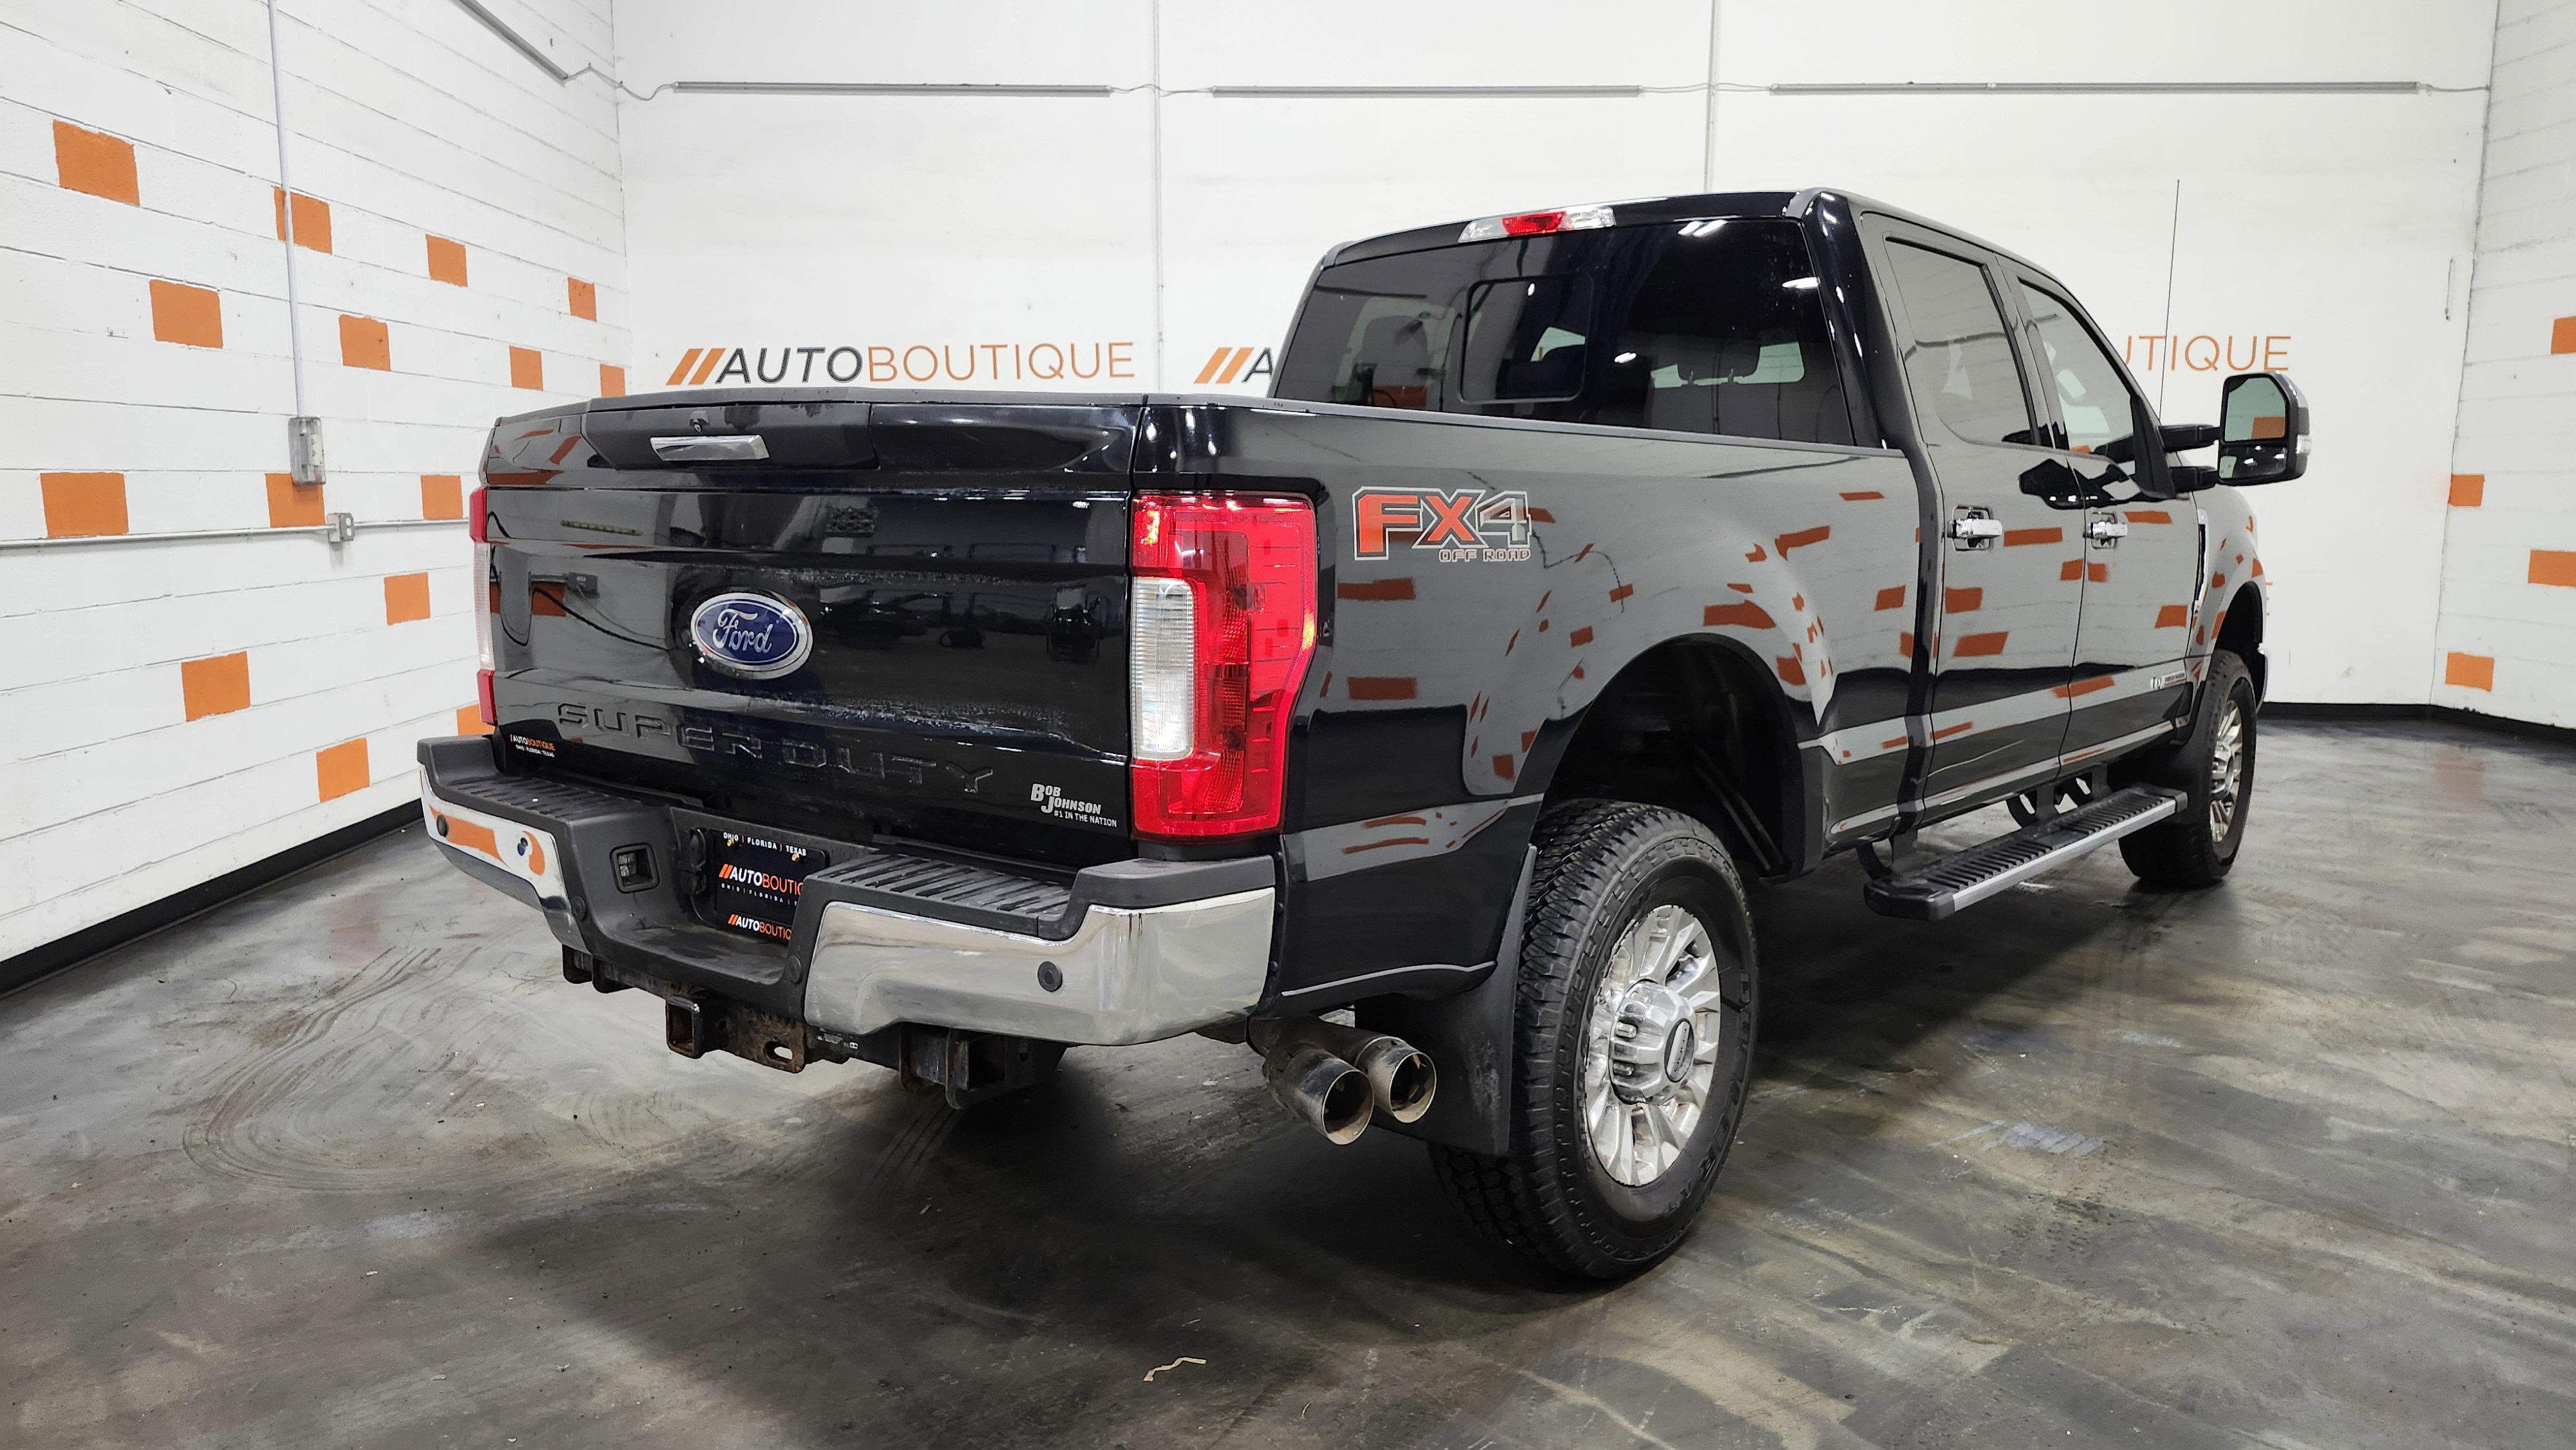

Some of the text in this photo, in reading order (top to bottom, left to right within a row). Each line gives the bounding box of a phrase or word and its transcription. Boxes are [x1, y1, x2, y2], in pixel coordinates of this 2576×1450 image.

[714, 341, 1135, 384] AUTOBOUTIQUE
[1352, 486, 1532, 561] FX4
[1439, 549, 1531, 562] OFF ROAD
[712, 608, 774, 654] Ford
[558, 702, 994, 794] SUPER DUTY
[1054, 809, 1117, 828] #1 IN THE NATION
[723, 831, 806, 856] OHIO FLORIDA TEXAS
